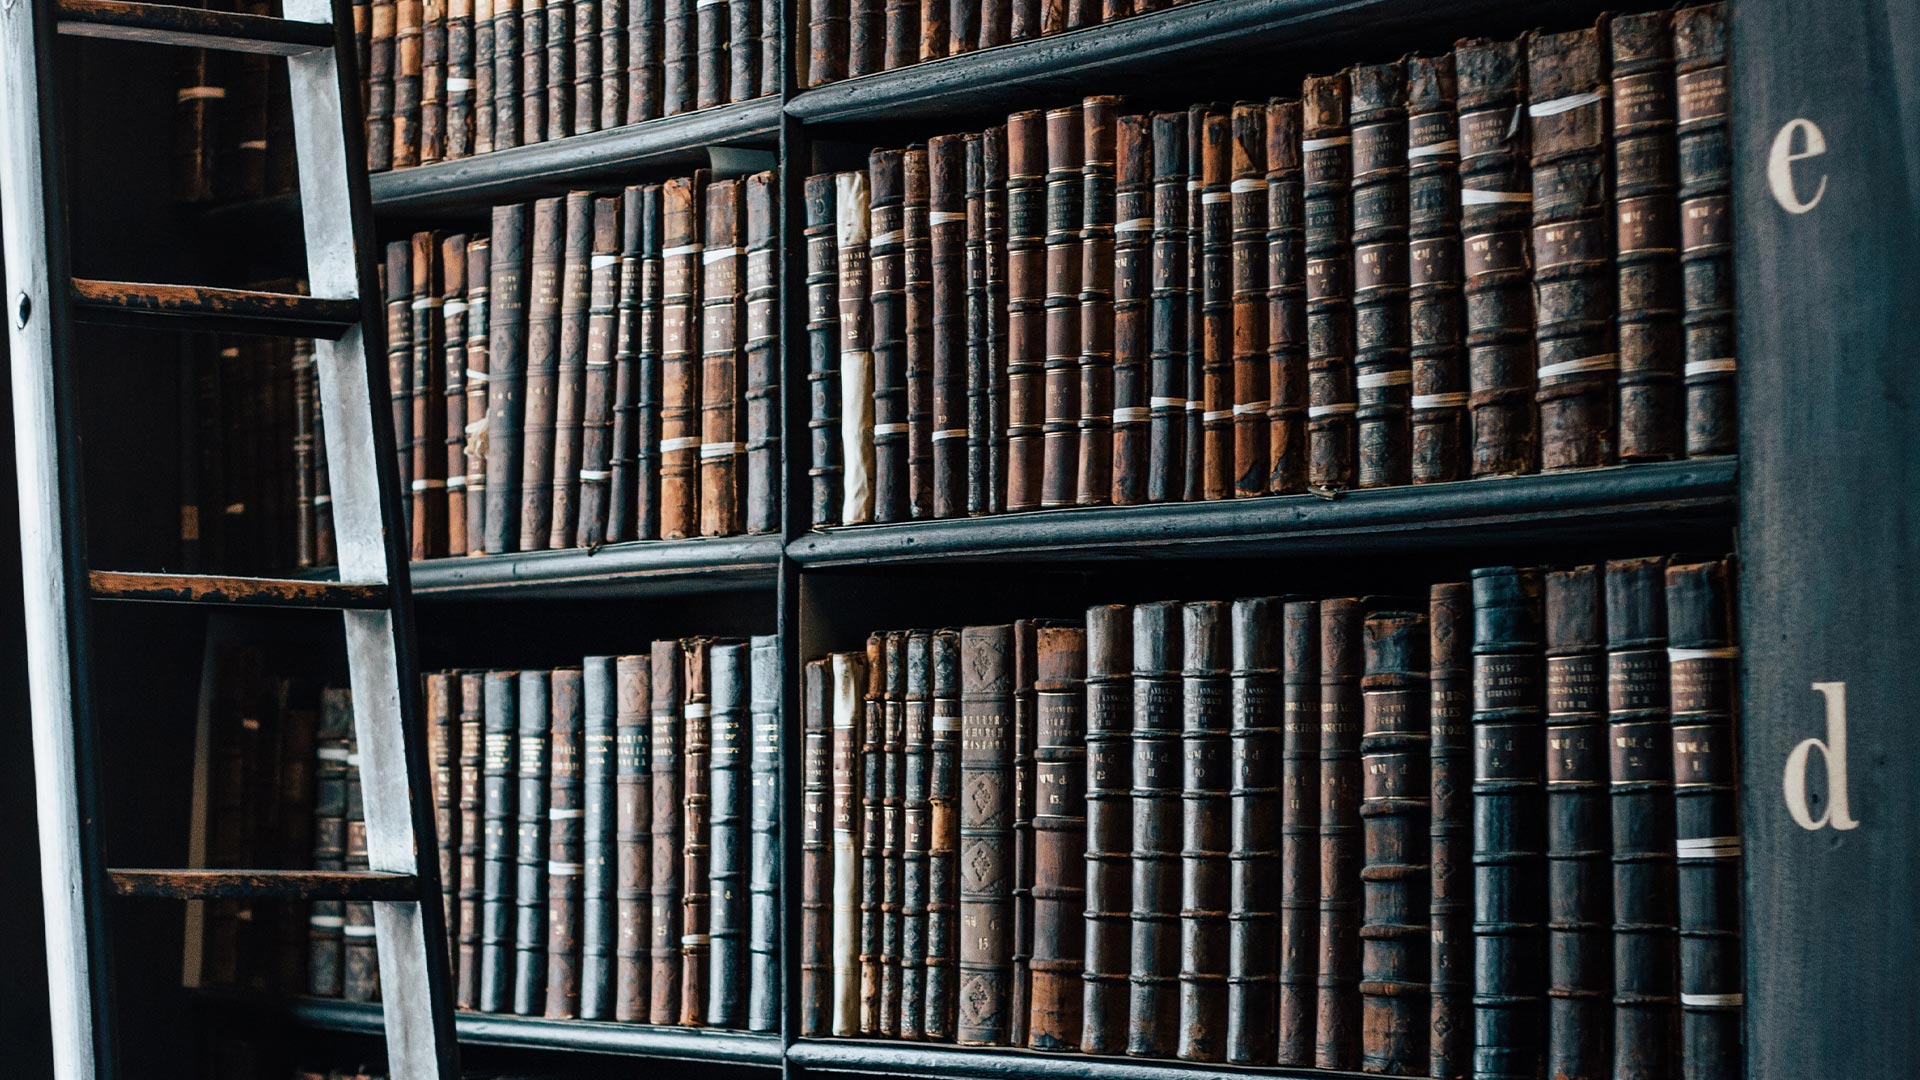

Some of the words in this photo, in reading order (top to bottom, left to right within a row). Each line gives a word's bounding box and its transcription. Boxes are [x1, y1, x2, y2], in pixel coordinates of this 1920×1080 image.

[1767, 118, 1827, 214] e
[1210, 279, 1221, 288] 10
[1320, 279, 1327, 289] 7
[965, 727, 1004, 738] CHURCH
[963, 739, 1007, 751] HISTORY
[1783, 681, 1860, 831] d
